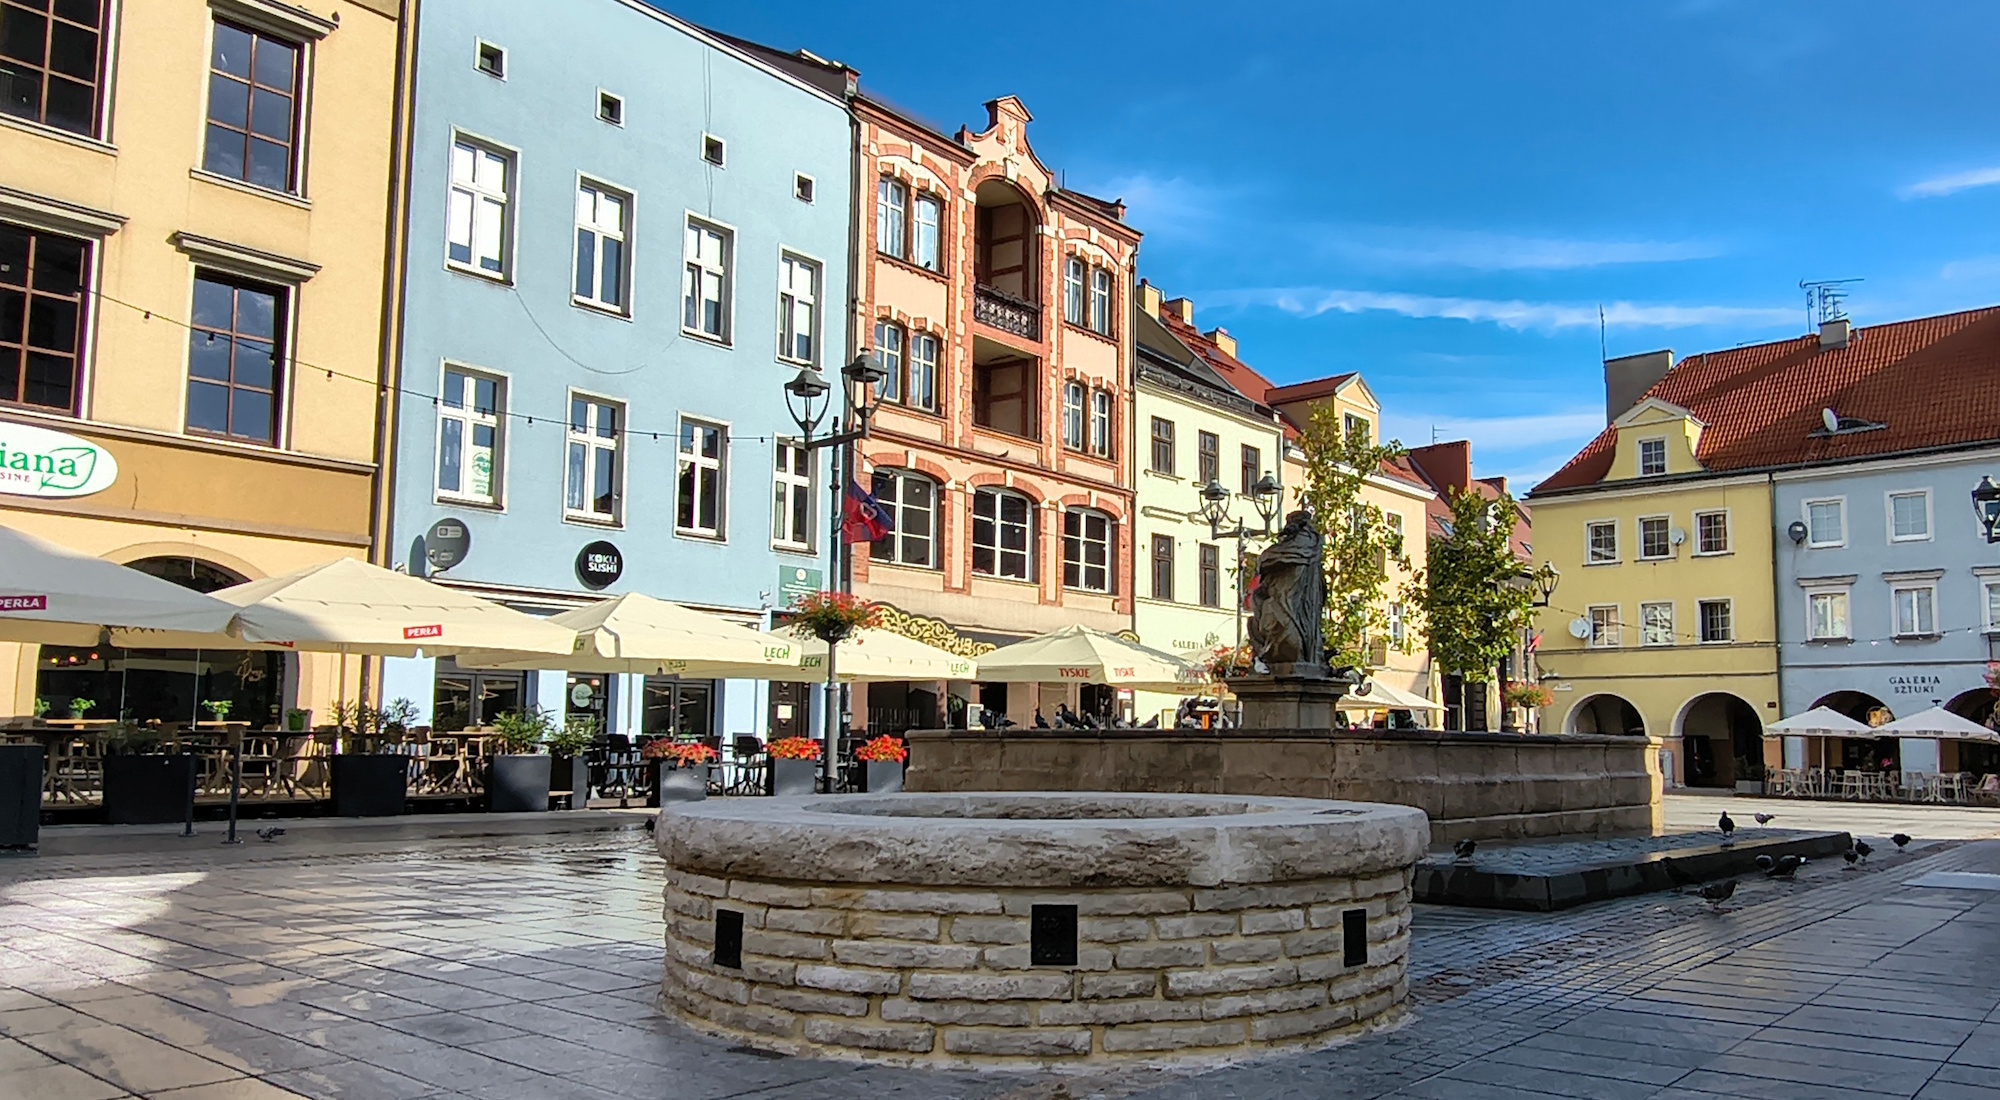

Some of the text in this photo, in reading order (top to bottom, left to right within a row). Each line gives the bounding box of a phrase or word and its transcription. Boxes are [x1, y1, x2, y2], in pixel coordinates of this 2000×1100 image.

[0, 442, 77, 477] iana
[0, 472, 30, 483] SINE
[588, 562, 617, 573] SUSHI
[407, 626, 439, 637] PERŁA
[764, 646, 790, 660] LECH
[801, 656, 822, 668] LECH
[1059, 667, 1090, 678] TYSKIE
[1114, 667, 1135, 677] TYSKIE
[1889, 675, 1941, 685] GALERIA
[1894, 685, 1935, 695] SZTUKI
